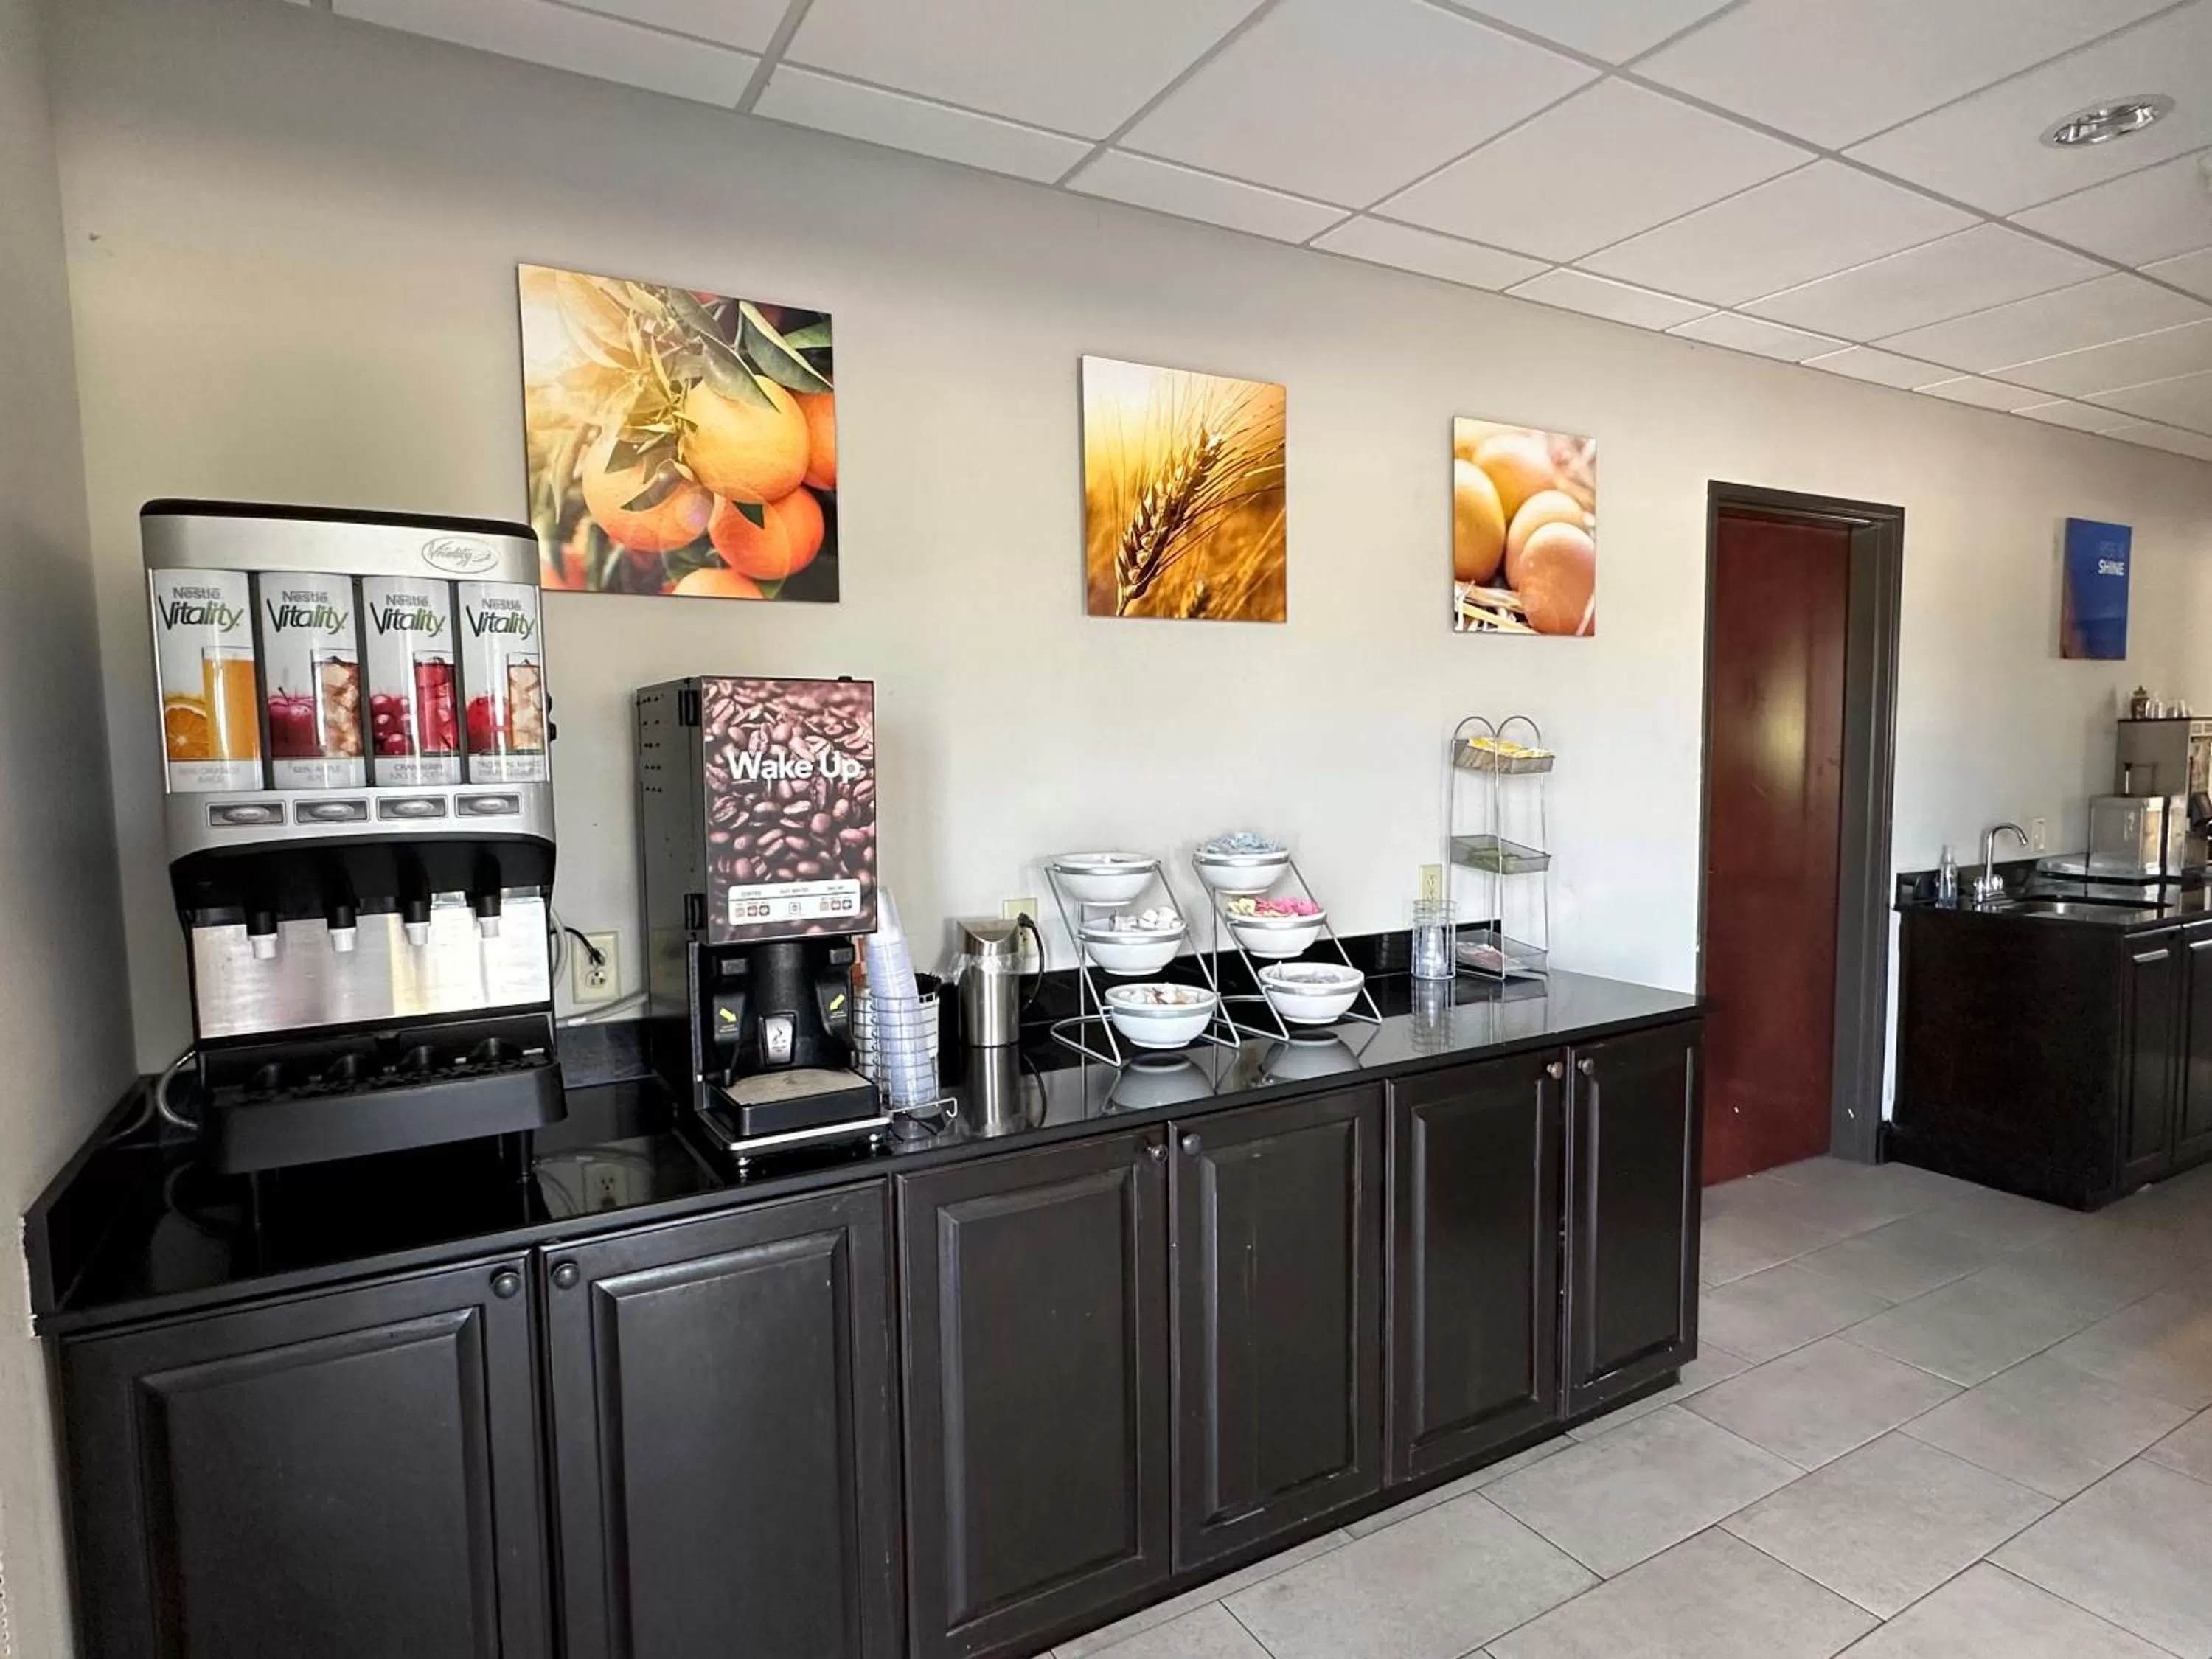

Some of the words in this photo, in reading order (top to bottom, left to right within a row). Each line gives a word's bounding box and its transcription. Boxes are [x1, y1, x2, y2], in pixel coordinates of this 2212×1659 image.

[2098, 558, 2124, 576] SHINE
[159, 595, 244, 633] Vitality
[266, 598, 349, 635] Vitality
[369, 602, 446, 638] Vitality
[465, 605, 535, 640] Vitality
[726, 751, 813, 780] Wake
[820, 750, 861, 784] Up
